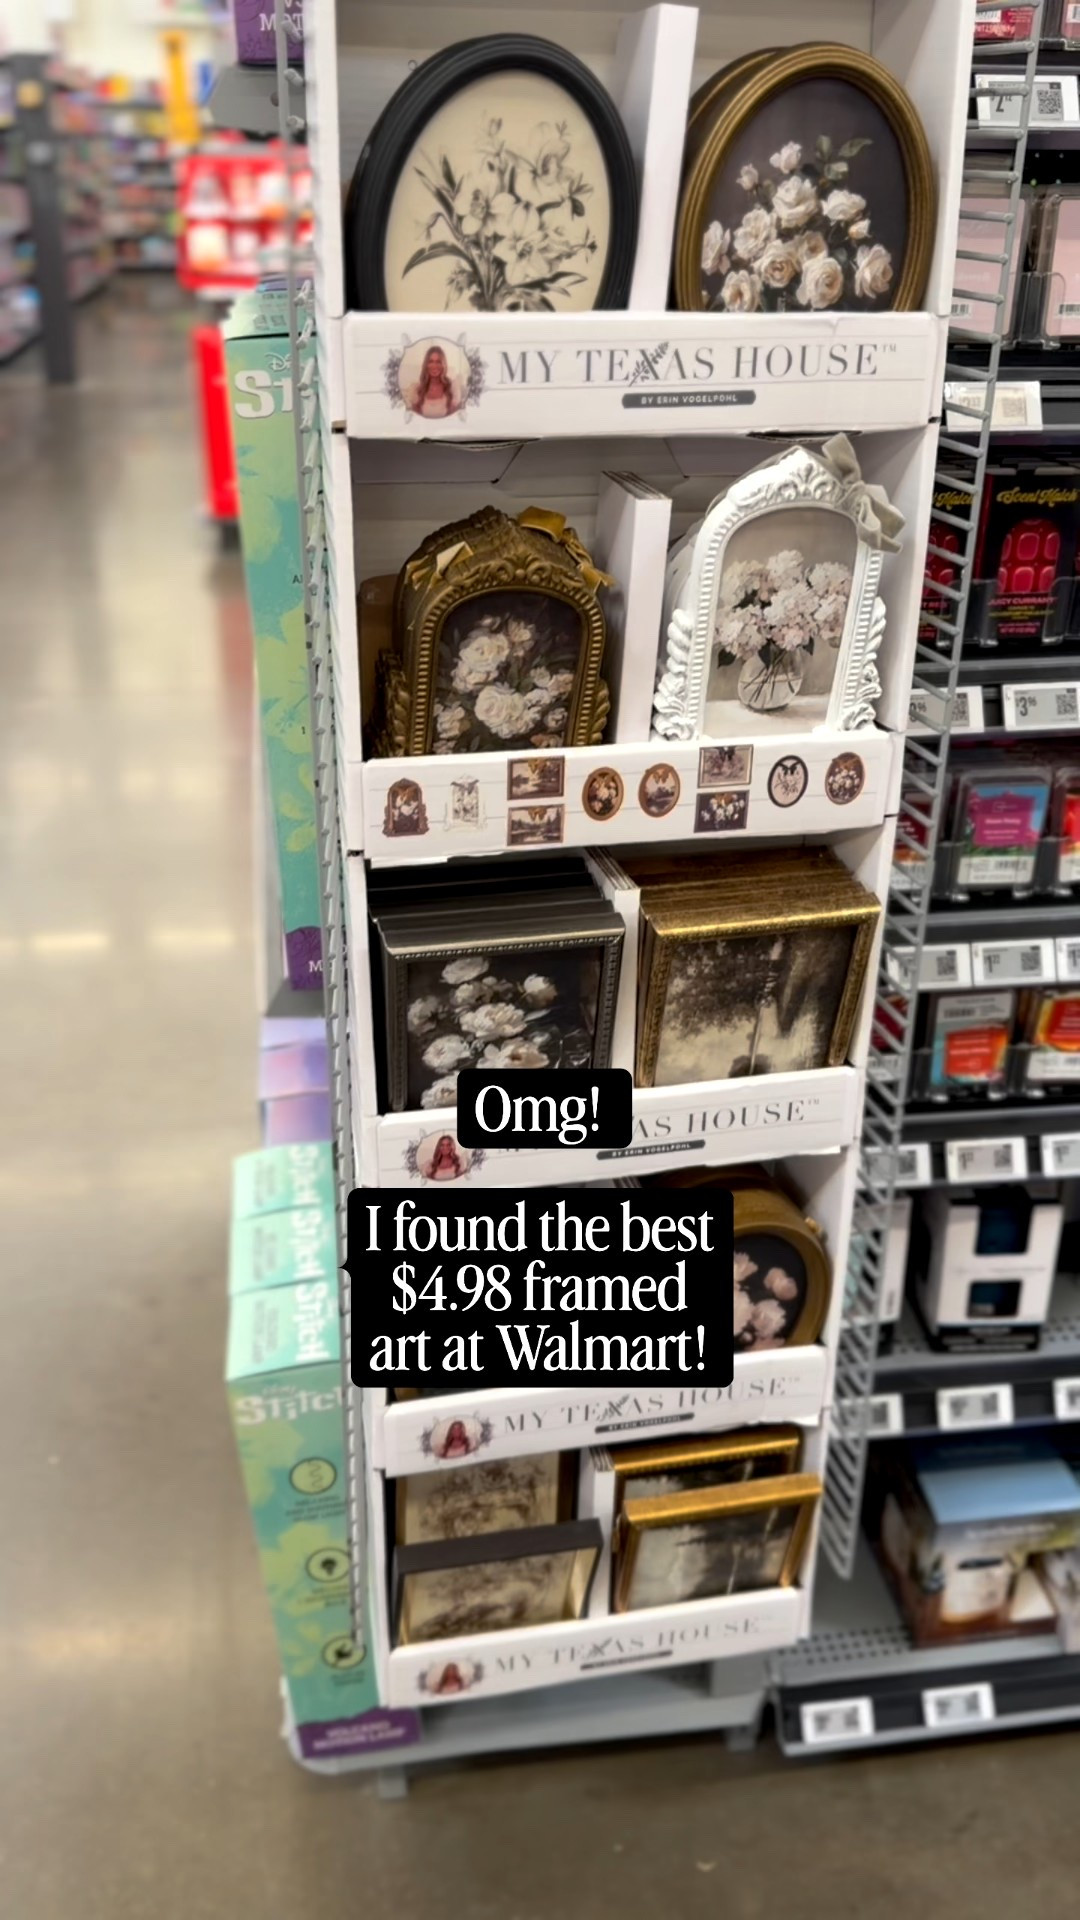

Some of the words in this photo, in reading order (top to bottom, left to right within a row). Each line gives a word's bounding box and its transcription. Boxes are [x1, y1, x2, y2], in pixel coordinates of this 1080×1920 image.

[499, 350, 560, 385] MY
[576, 342, 714, 387] TEXAS
[640, 395, 654, 405] BY
[656, 394, 680, 405] ERIN
[682, 392, 738, 404] VOGELPOHL
[996, 486, 1040, 505] Scent
[505, 1410, 547, 1433] MY
[561, 1394, 664, 1424] TEXAS
